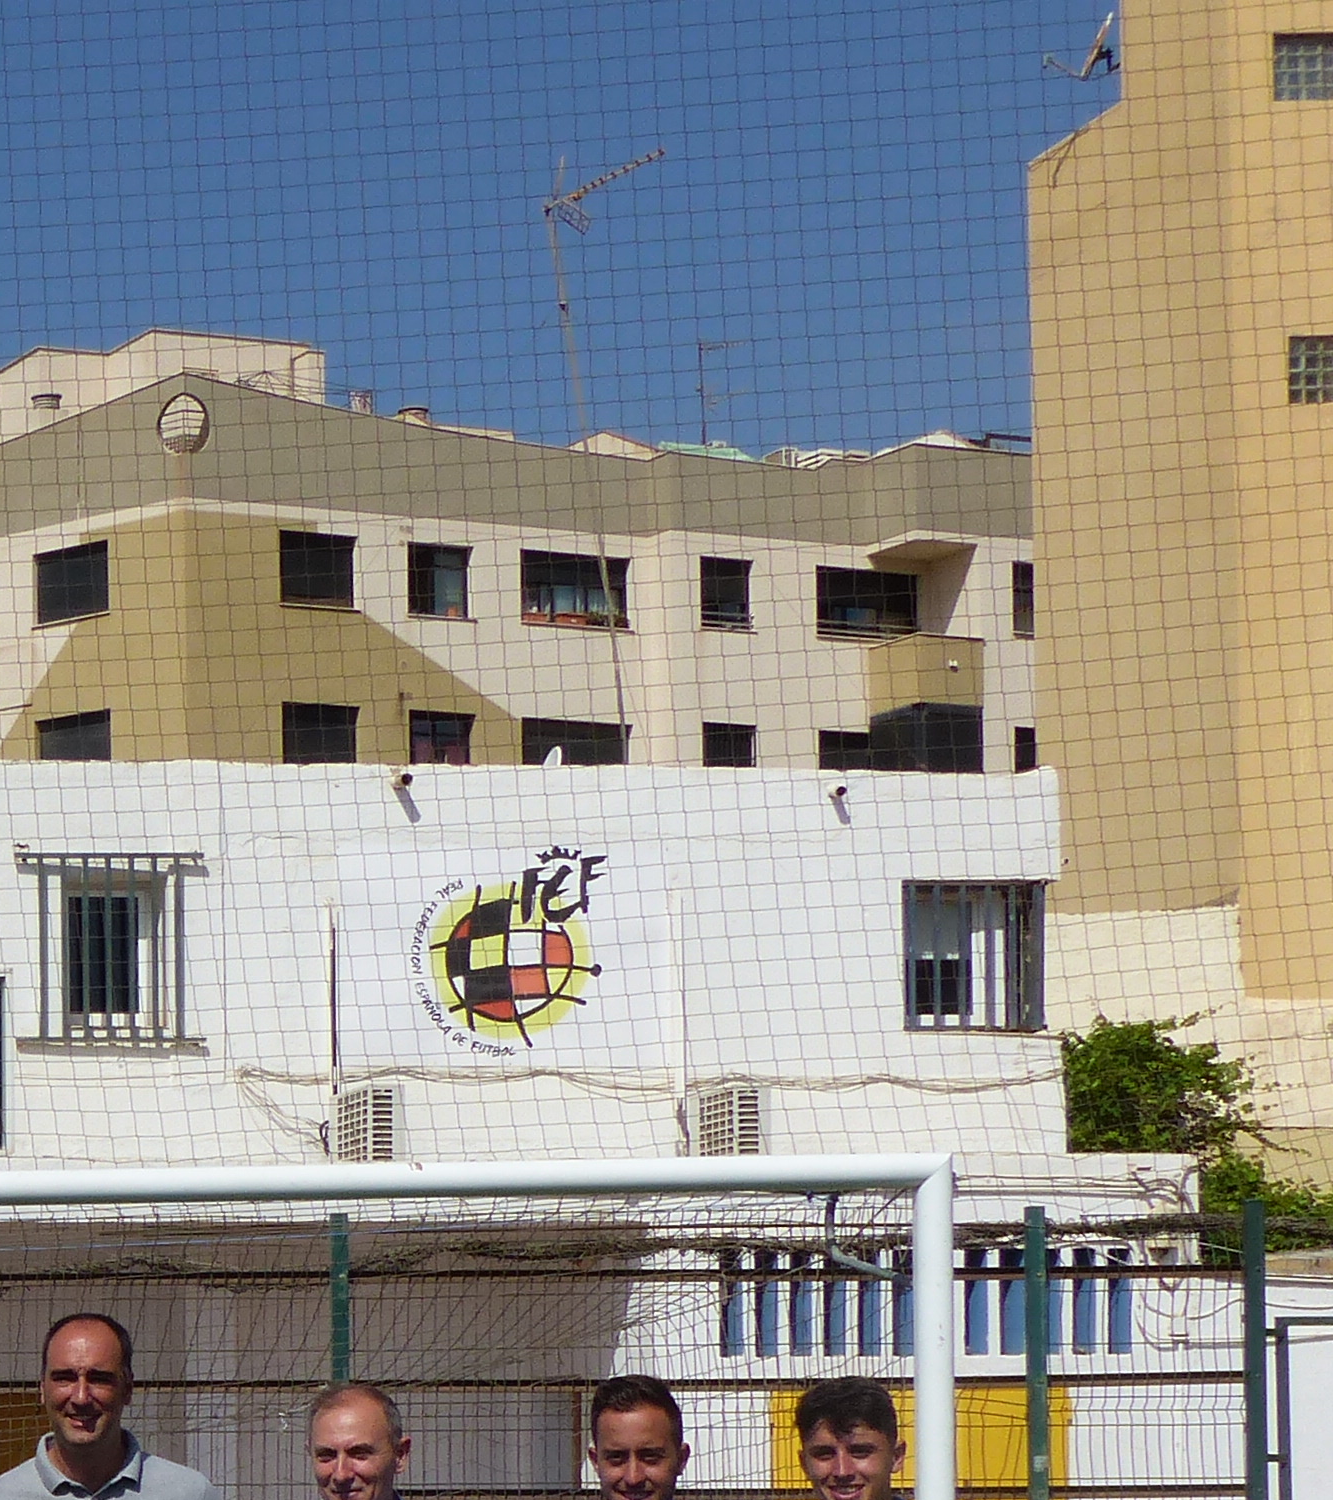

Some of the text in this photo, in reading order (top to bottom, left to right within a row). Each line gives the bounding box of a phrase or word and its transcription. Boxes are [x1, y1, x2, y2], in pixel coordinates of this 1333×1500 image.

[410, 879, 517, 1057] REAL FEDERACION ESPAÑOLA DE FUTBOL
